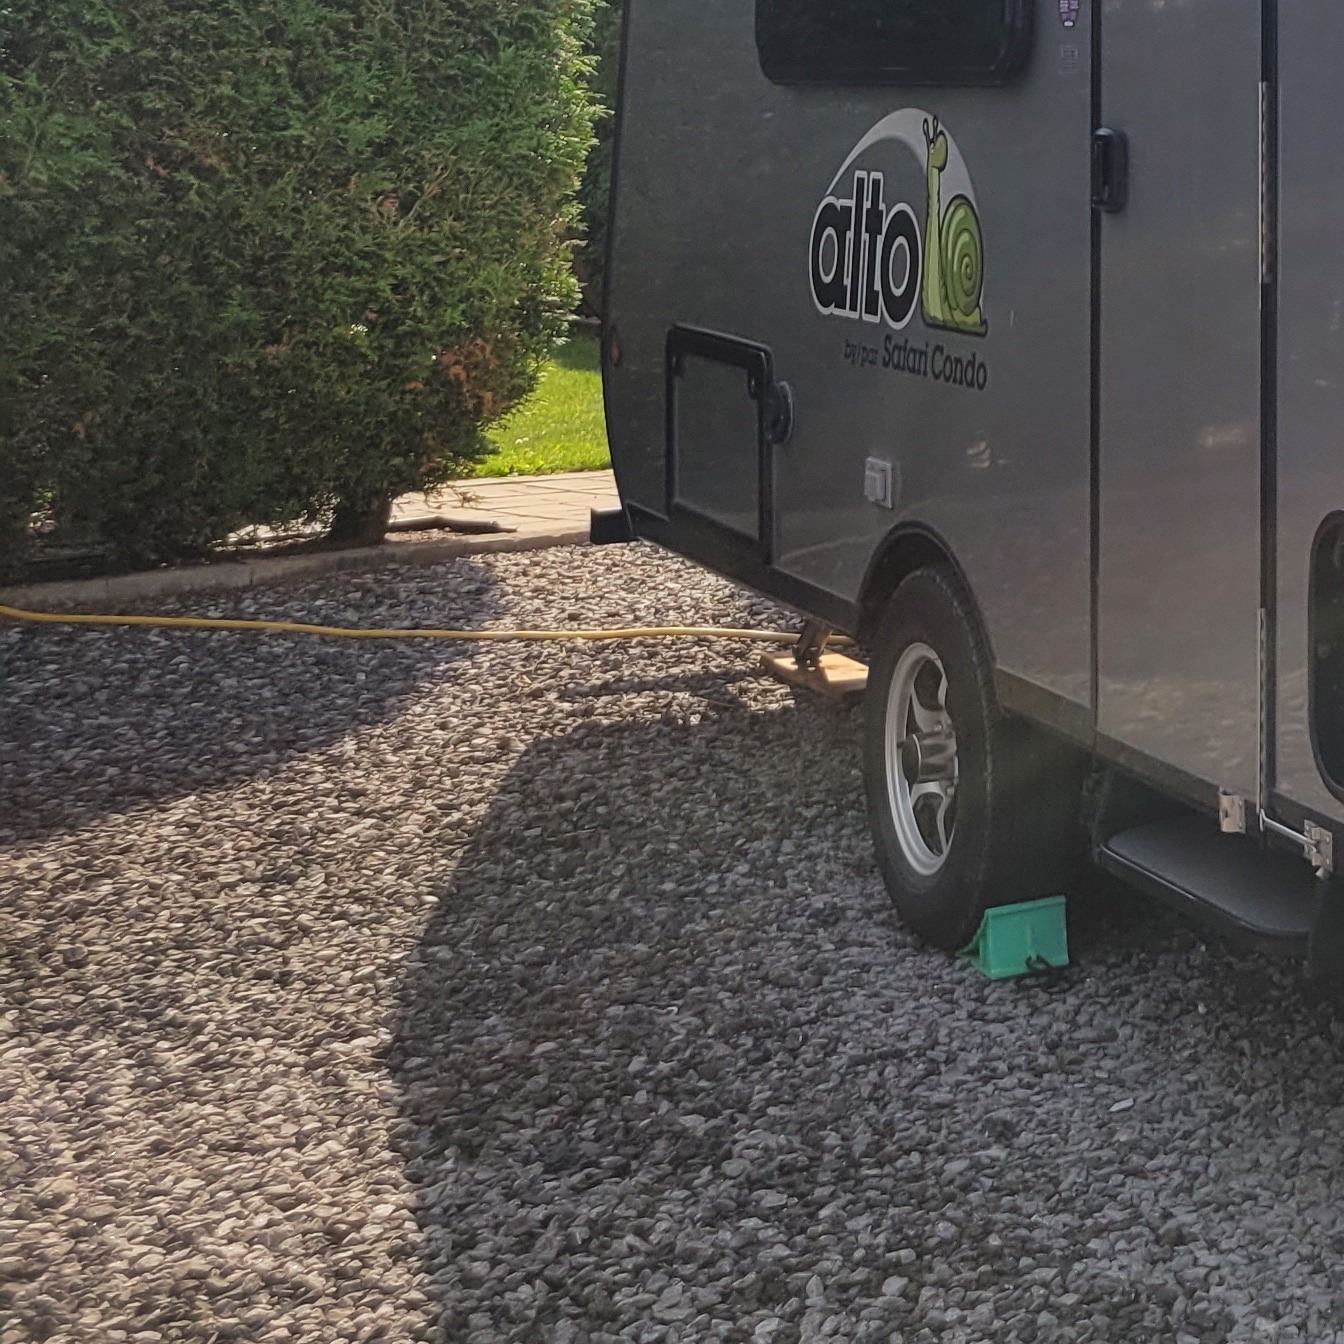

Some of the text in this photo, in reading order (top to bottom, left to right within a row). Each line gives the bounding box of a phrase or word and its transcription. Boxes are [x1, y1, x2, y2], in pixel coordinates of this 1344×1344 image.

[809, 170, 922, 330] alto
[882, 334, 929, 377] Safari
[931, 344, 988, 391] Condo
